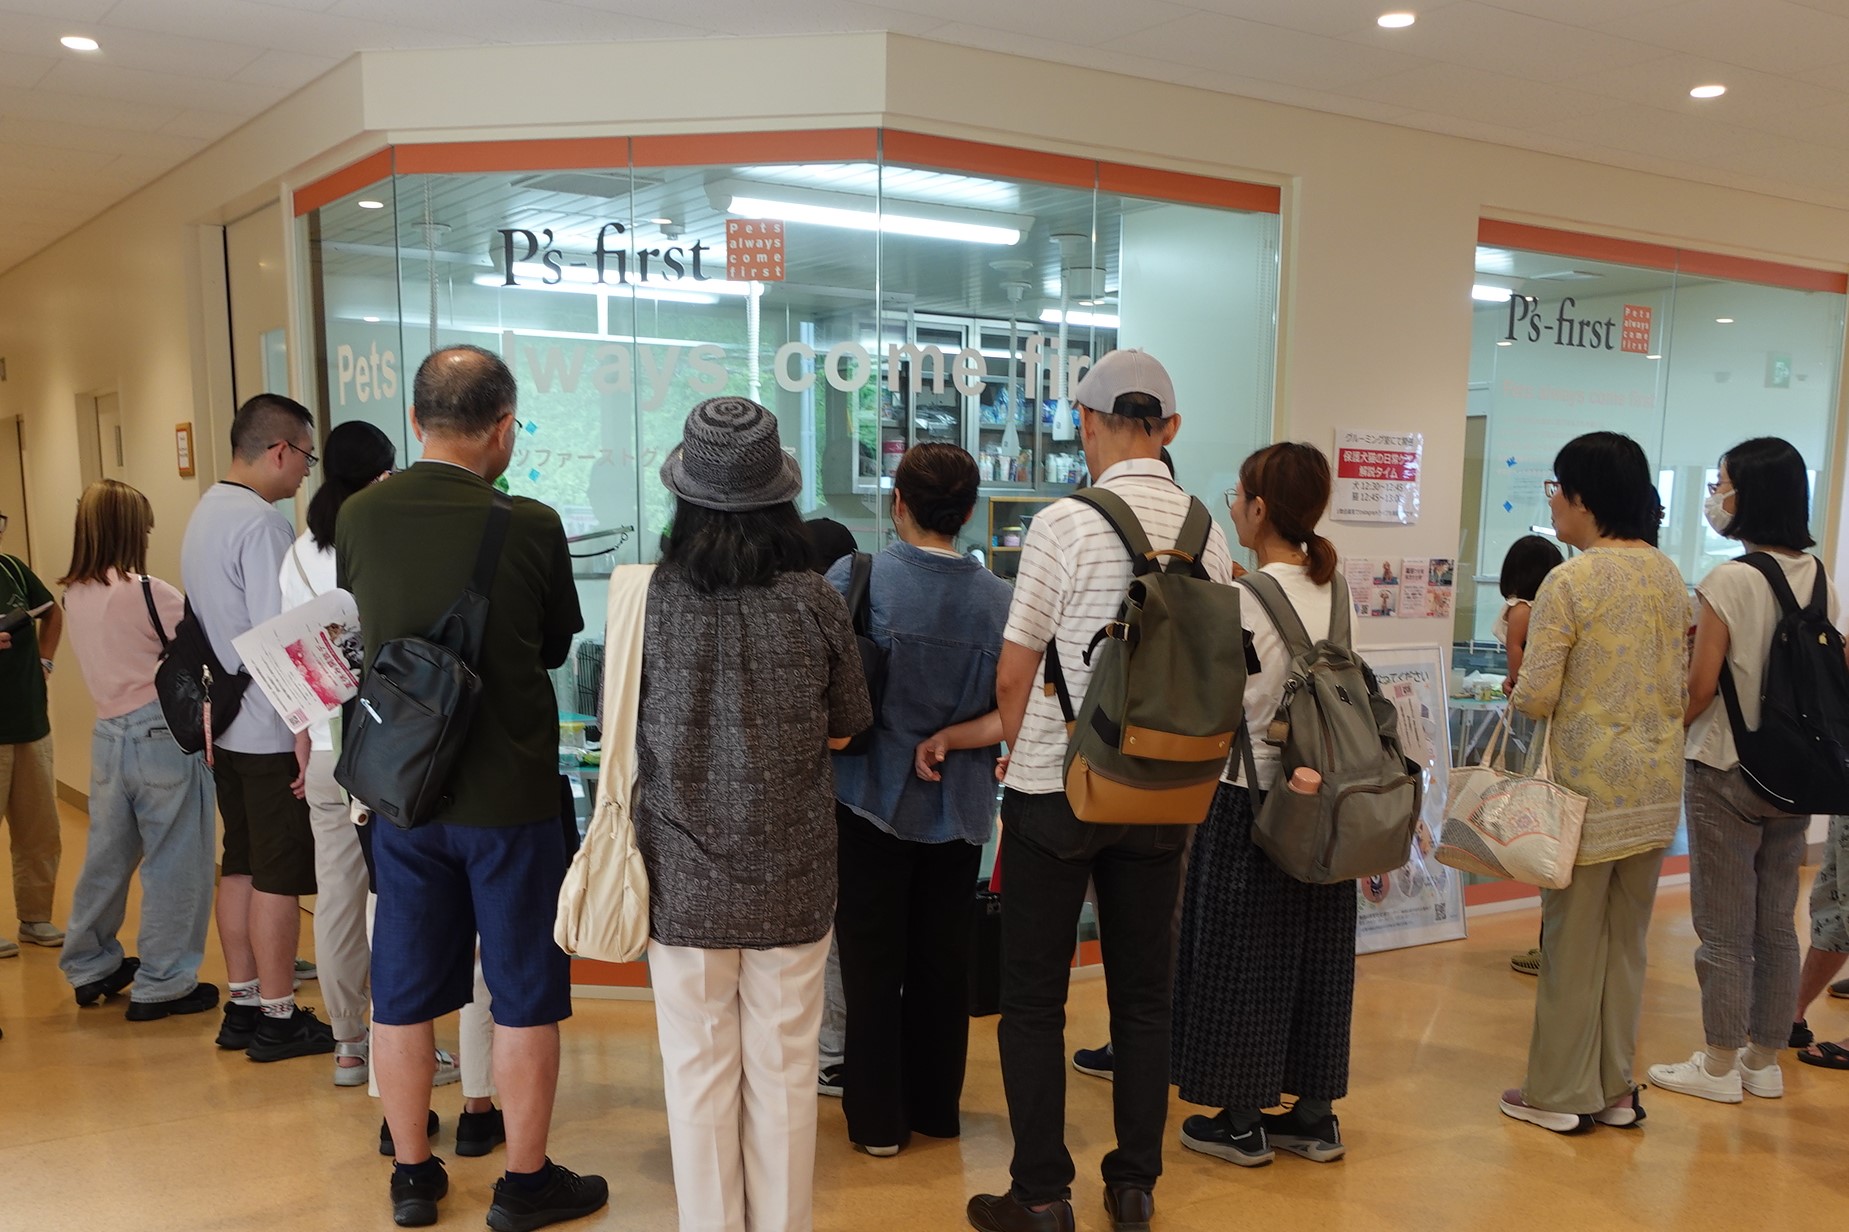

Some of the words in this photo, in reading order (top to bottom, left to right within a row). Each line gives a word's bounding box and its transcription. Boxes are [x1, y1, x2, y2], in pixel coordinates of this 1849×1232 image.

[729, 223, 782, 235] Pets
[729, 237, 782, 252] always
[497, 222, 712, 287] P's-first
[729, 253, 782, 263] come
[729, 265, 782, 278] first
[1503, 293, 1616, 352] P's-first
[1623, 318, 1650, 331] always
[1622, 330, 1649, 341] come
[336, 340, 397, 406] Pets
[503, 331, 728, 412] lways
[774, 340, 987, 397] come
